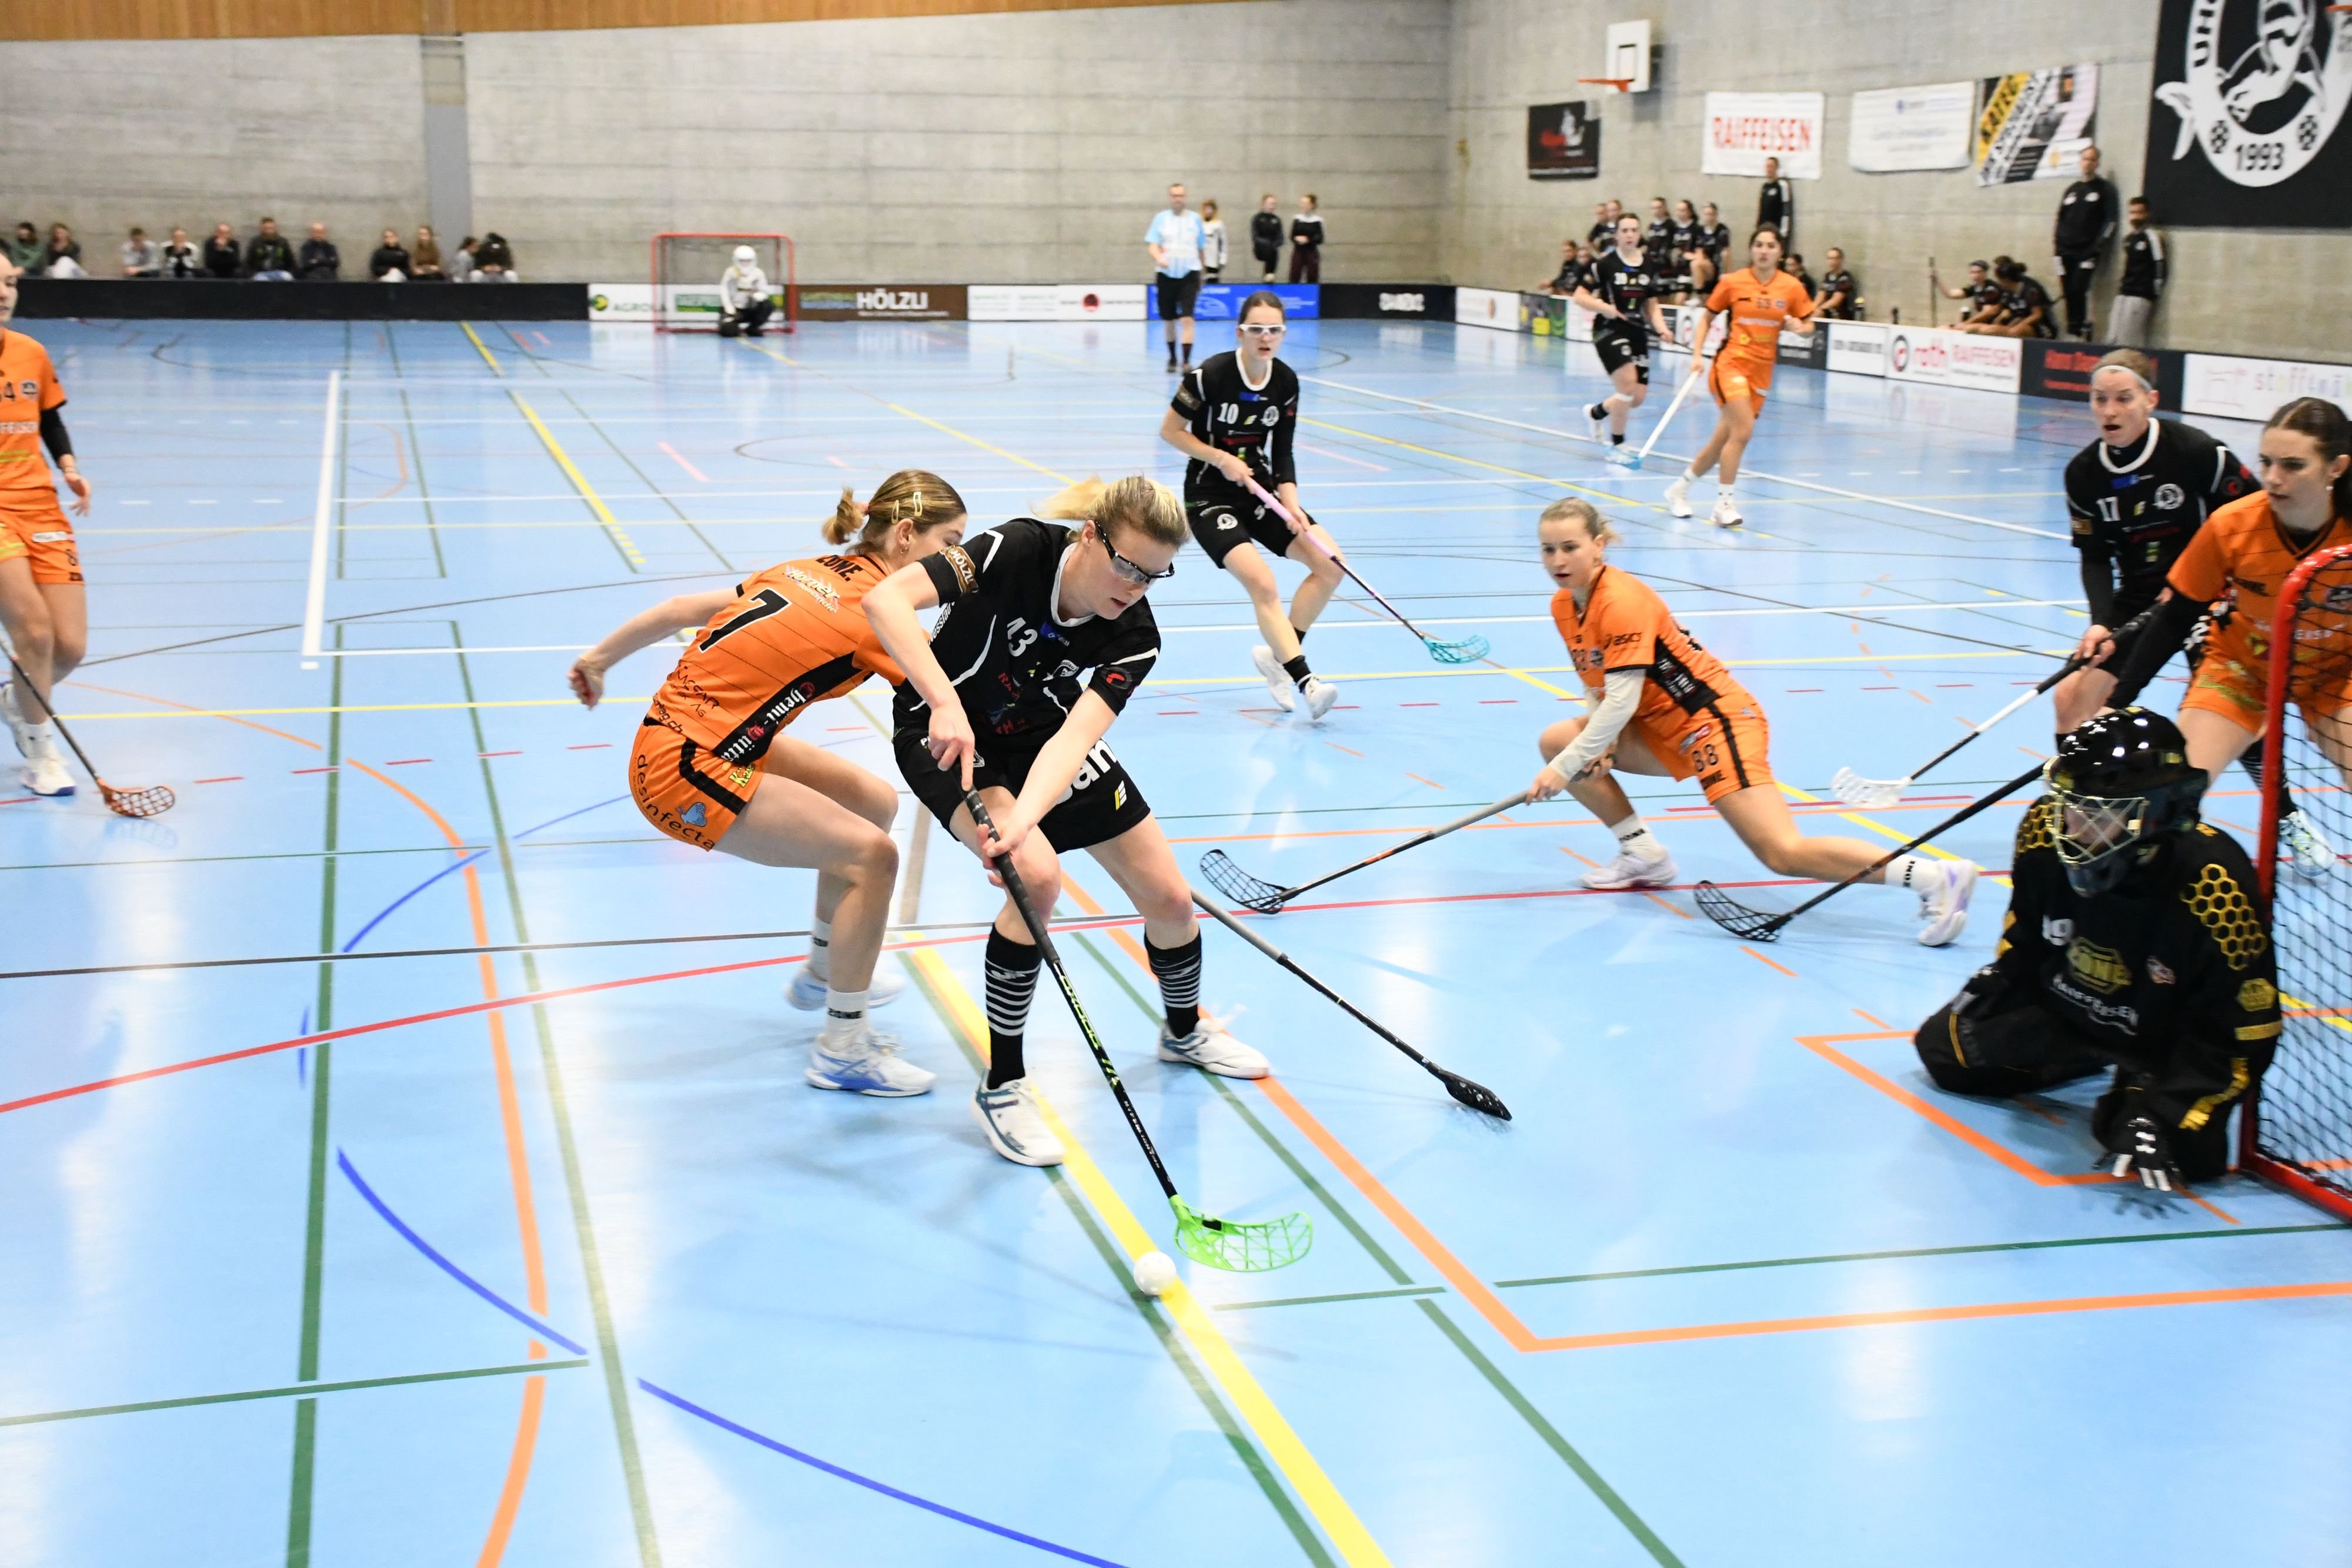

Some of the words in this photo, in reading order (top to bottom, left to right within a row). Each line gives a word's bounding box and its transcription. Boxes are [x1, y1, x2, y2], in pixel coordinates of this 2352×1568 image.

[2194, 0, 2216, 68] UH
[1712, 116, 1813, 152] RAIFFEISEN
[2236, 143, 2284, 170] 1993
[856, 287, 928, 310] HÖLZLI
[0, 380, 15, 401] 4
[1217, 402, 1240, 424] 10
[2096, 496, 2122, 522] 17
[699, 587, 793, 654] 7
[1692, 743, 1718, 773] 88
[637, 754, 716, 850] desinfecta
